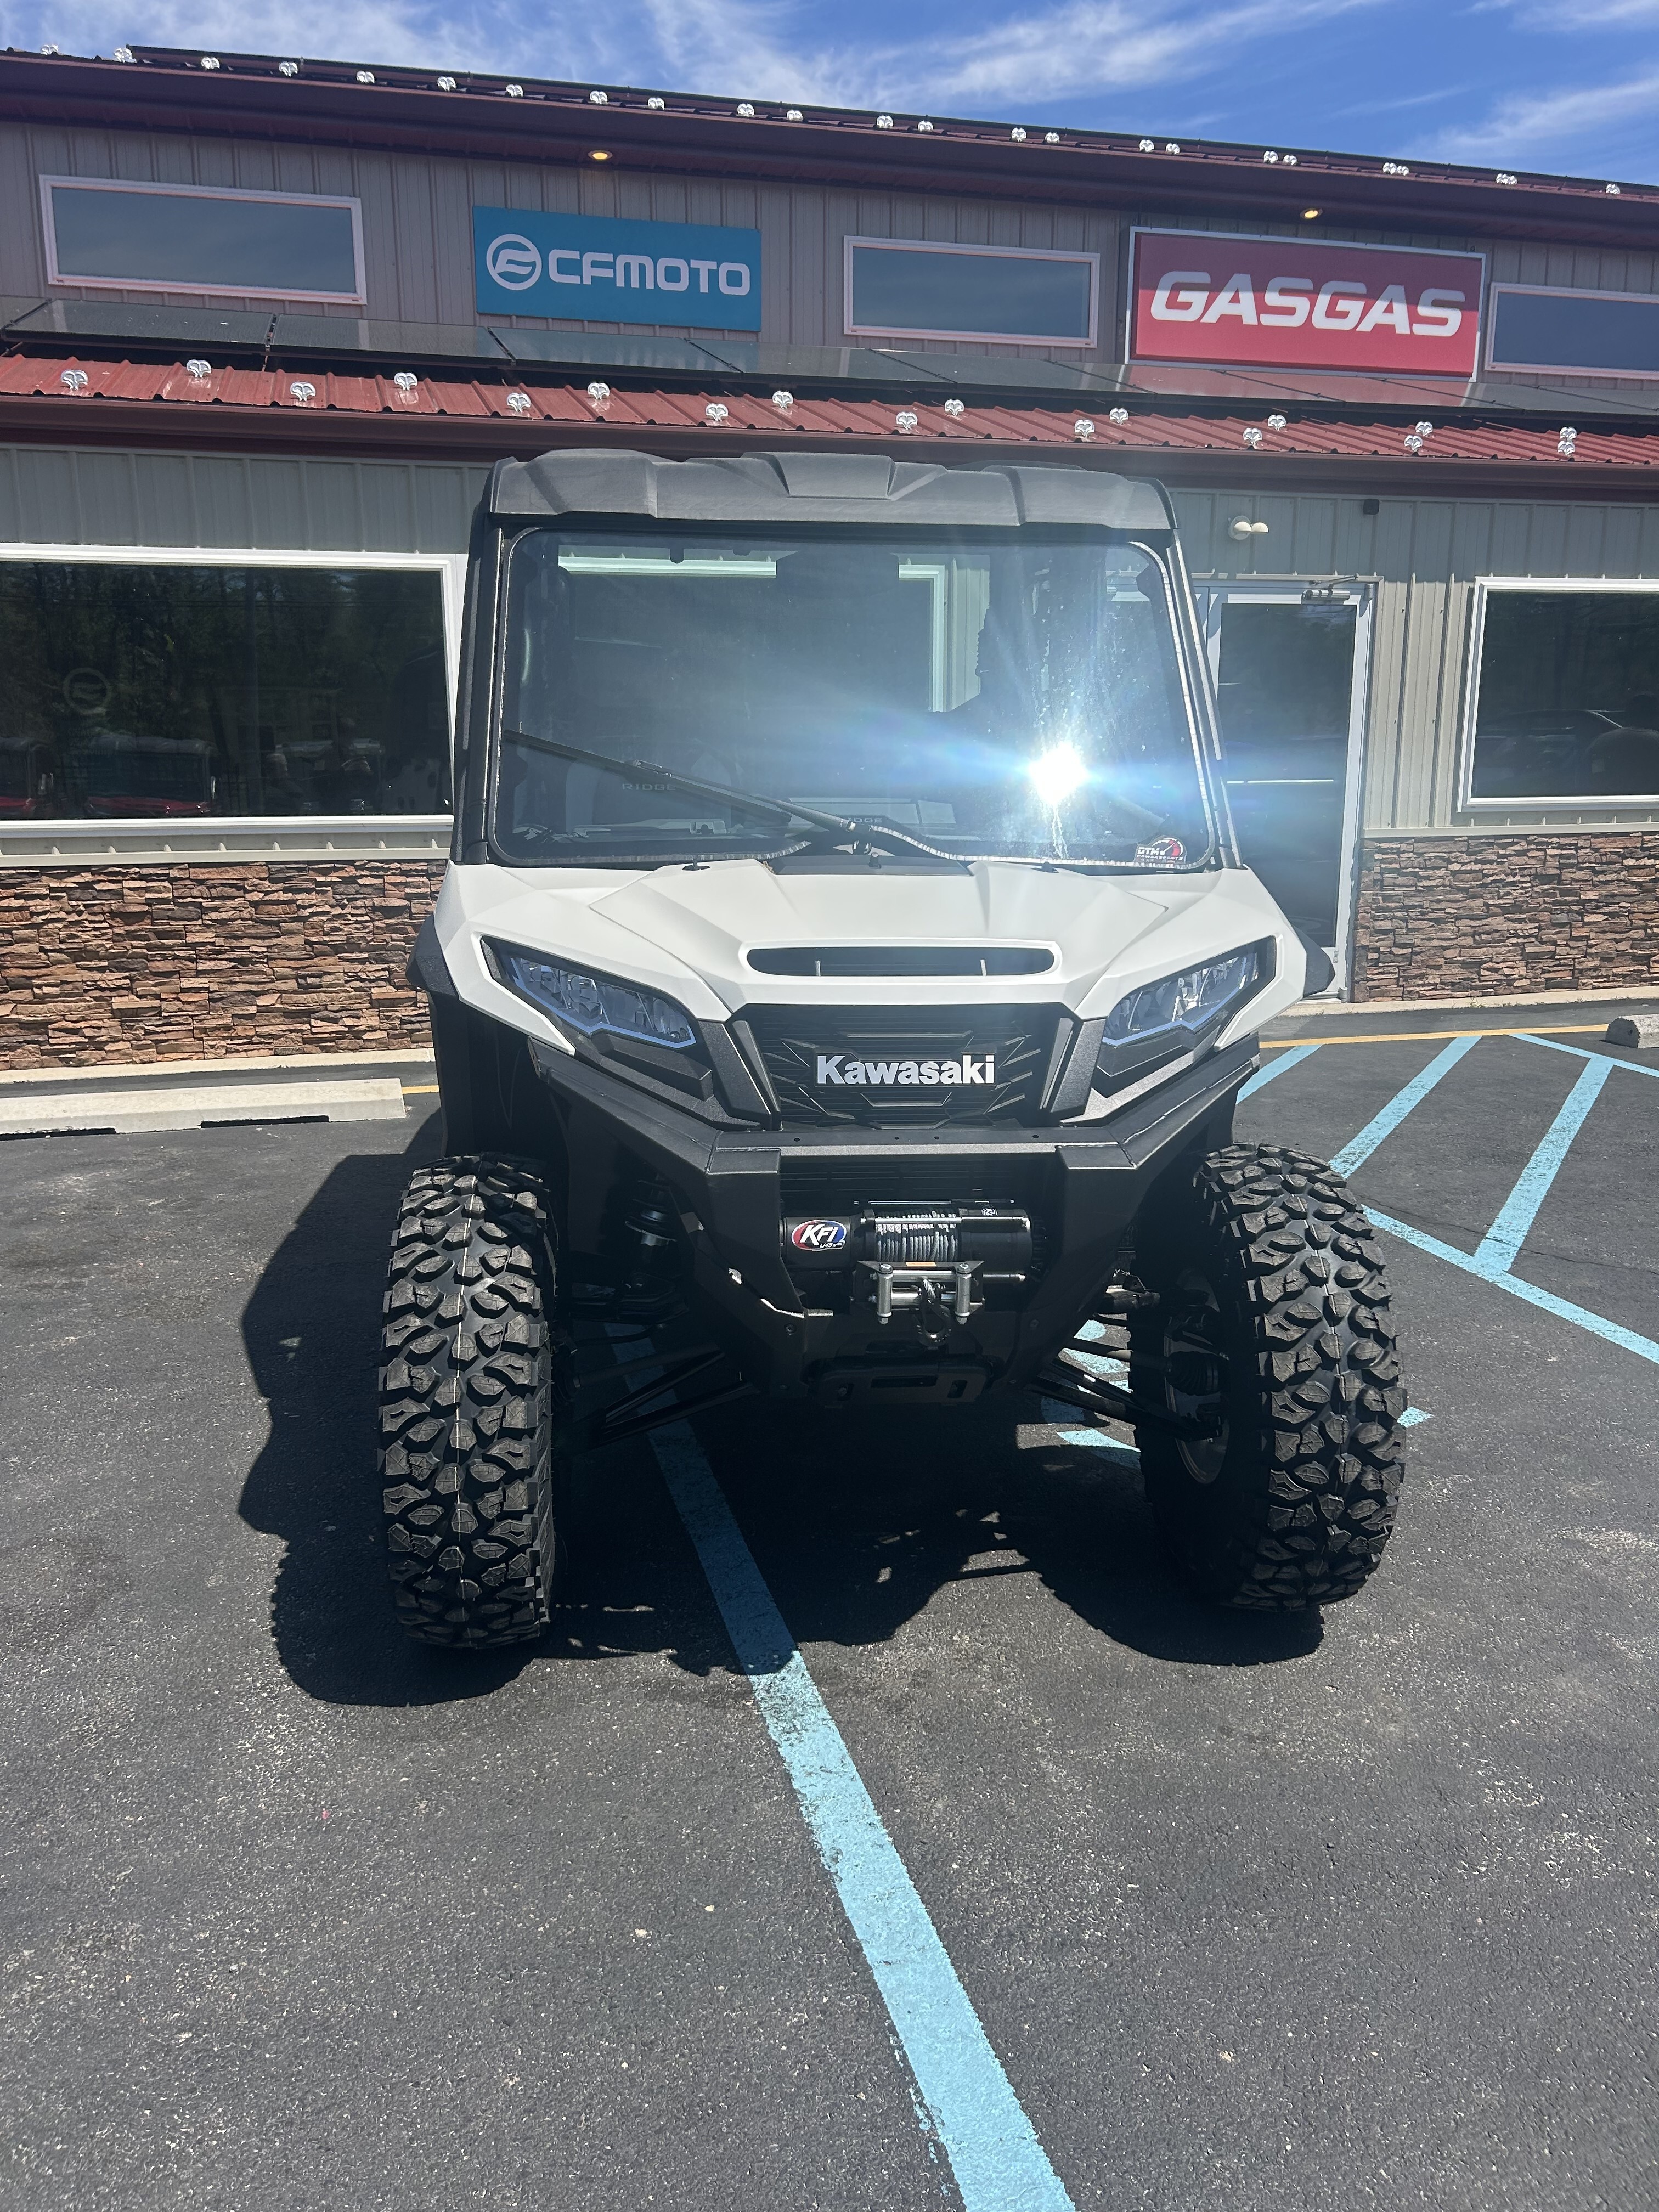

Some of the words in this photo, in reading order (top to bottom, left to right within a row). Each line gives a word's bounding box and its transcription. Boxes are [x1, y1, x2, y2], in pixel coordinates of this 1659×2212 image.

[549, 249, 751, 296] CFMOTO
[1150, 270, 1466, 337] GASGAS
[1137, 847, 1160, 855] DTM
[817, 1054, 995, 1085] Kawasaki
